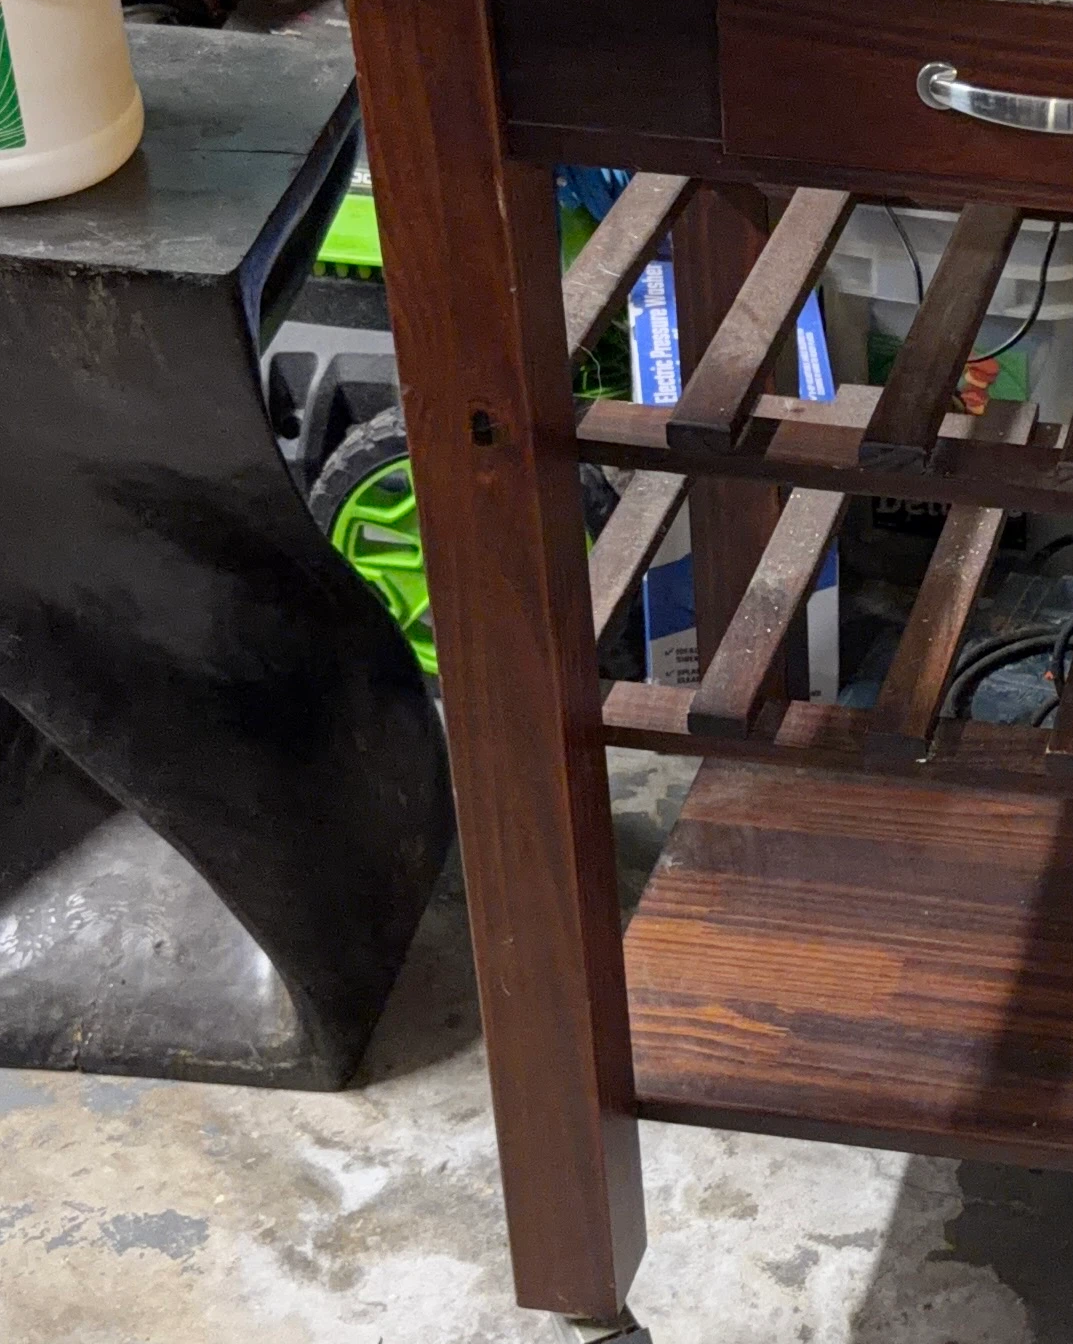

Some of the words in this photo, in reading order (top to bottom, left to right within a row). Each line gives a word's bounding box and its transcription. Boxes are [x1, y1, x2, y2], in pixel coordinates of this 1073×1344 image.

[641, 264, 667, 308] Washer
[649, 308, 673, 359] Pressure
[650, 359, 678, 404] Electric
